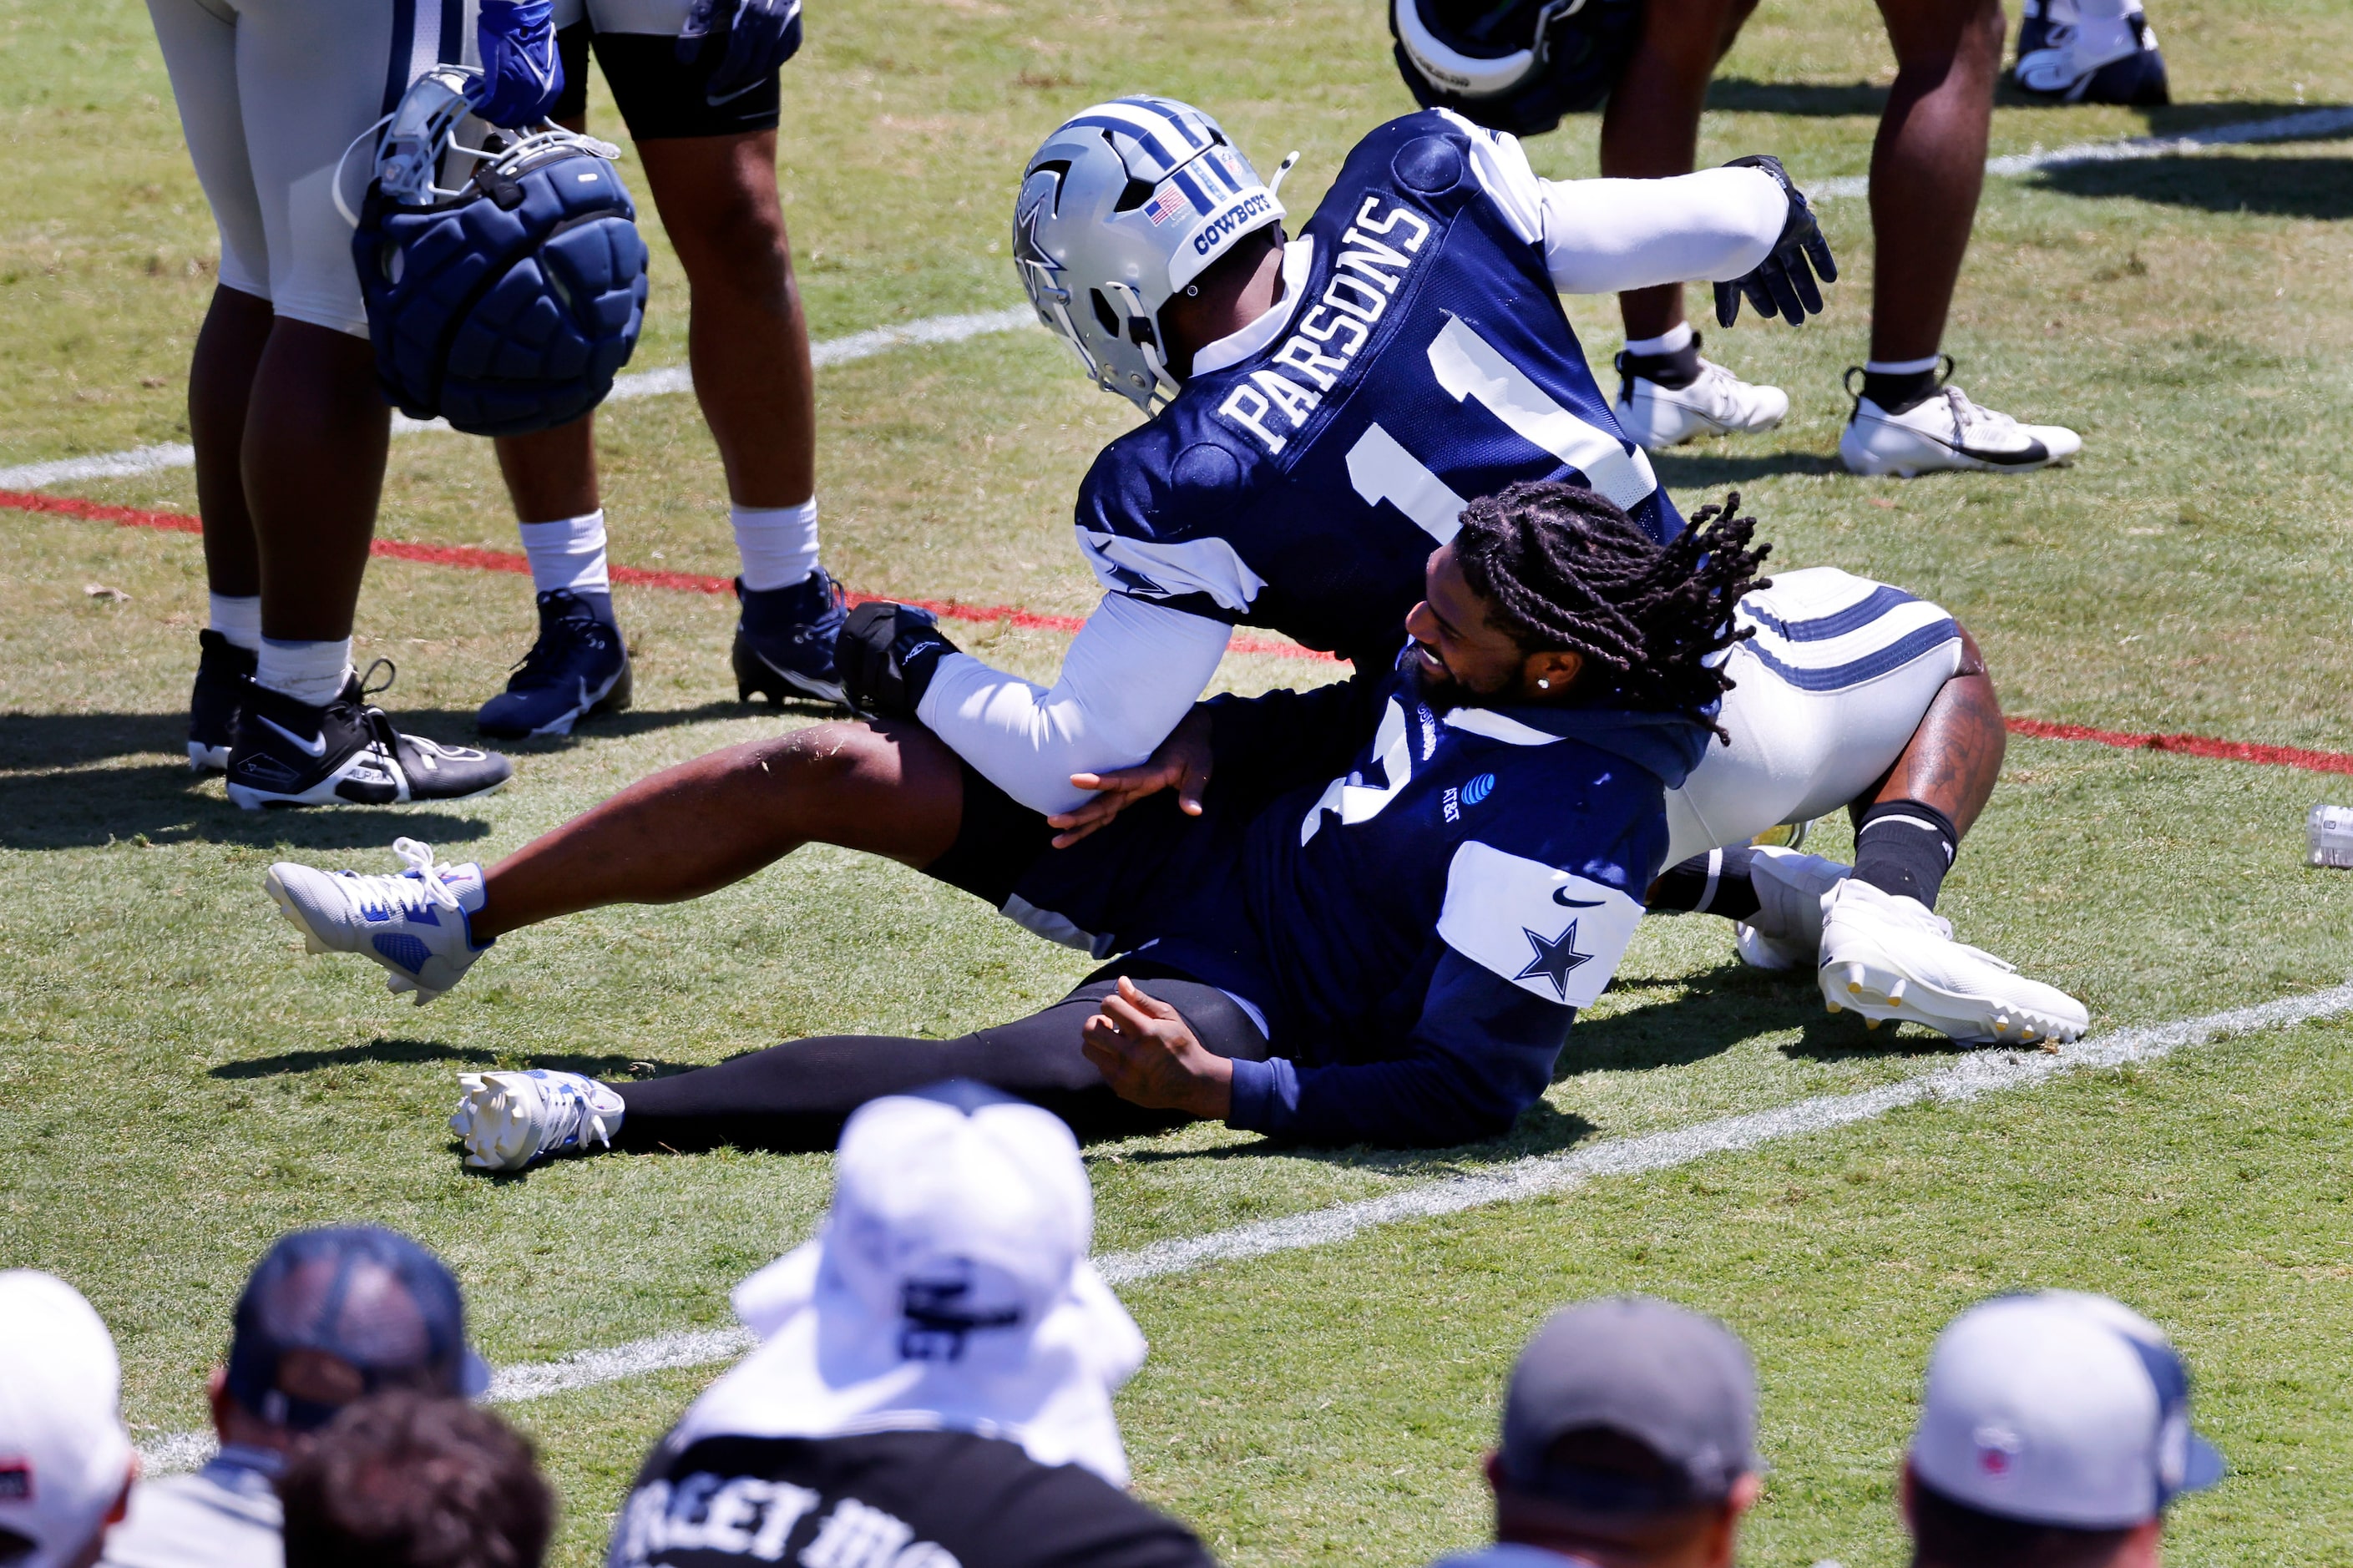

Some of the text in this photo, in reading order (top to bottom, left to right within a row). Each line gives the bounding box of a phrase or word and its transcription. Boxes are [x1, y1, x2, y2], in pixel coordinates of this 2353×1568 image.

[1193, 193, 1272, 255] COWBOYS
[1217, 195, 1430, 456] PARSONS
[1345, 312, 1657, 545] 11
[1443, 787, 1460, 823] AT&T
